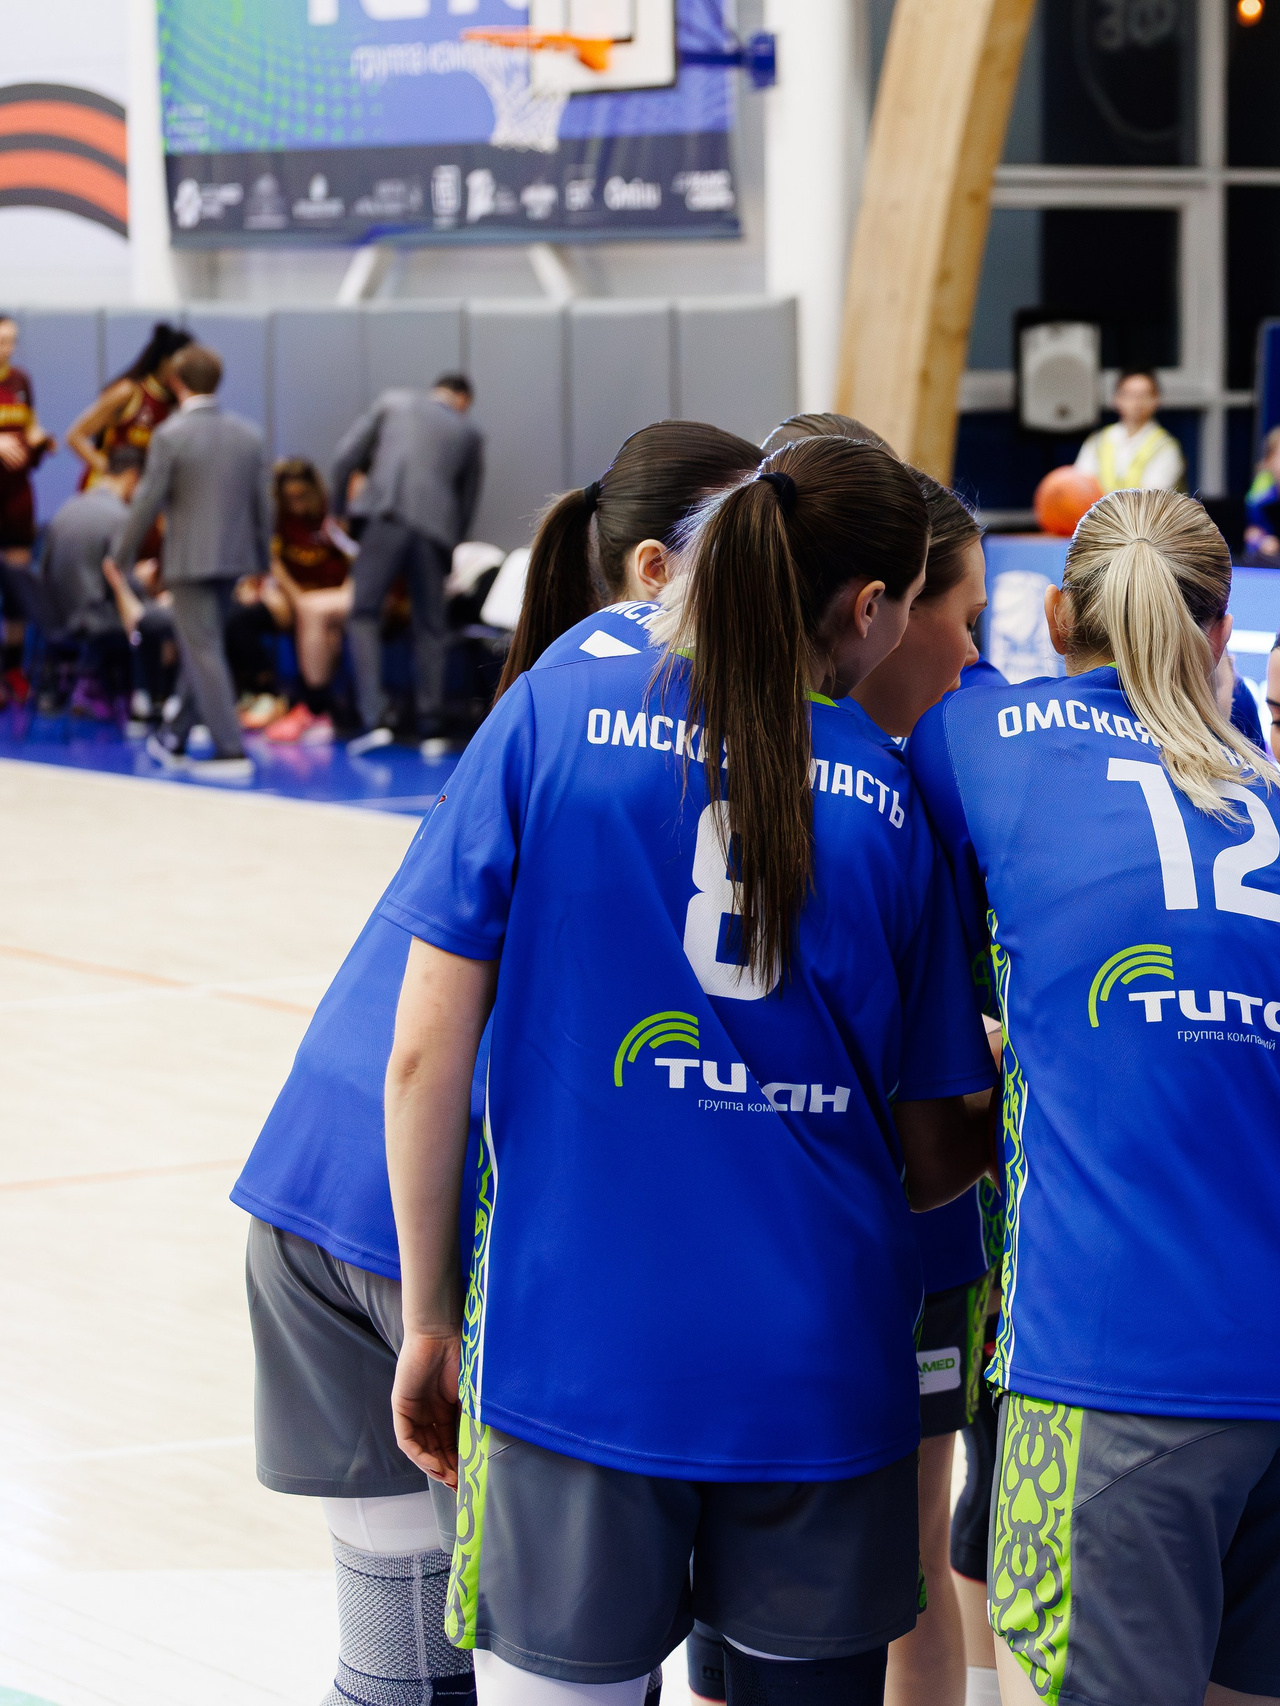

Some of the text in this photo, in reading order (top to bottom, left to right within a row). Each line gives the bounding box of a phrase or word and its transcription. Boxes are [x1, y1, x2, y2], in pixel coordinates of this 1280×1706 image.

[587, 708, 905, 829] ОМСК ЛАСТЬ
[683, 800, 782, 1000] 8
[1177, 1030, 1225, 1043] группа
[698, 1099, 744, 1112] группа
